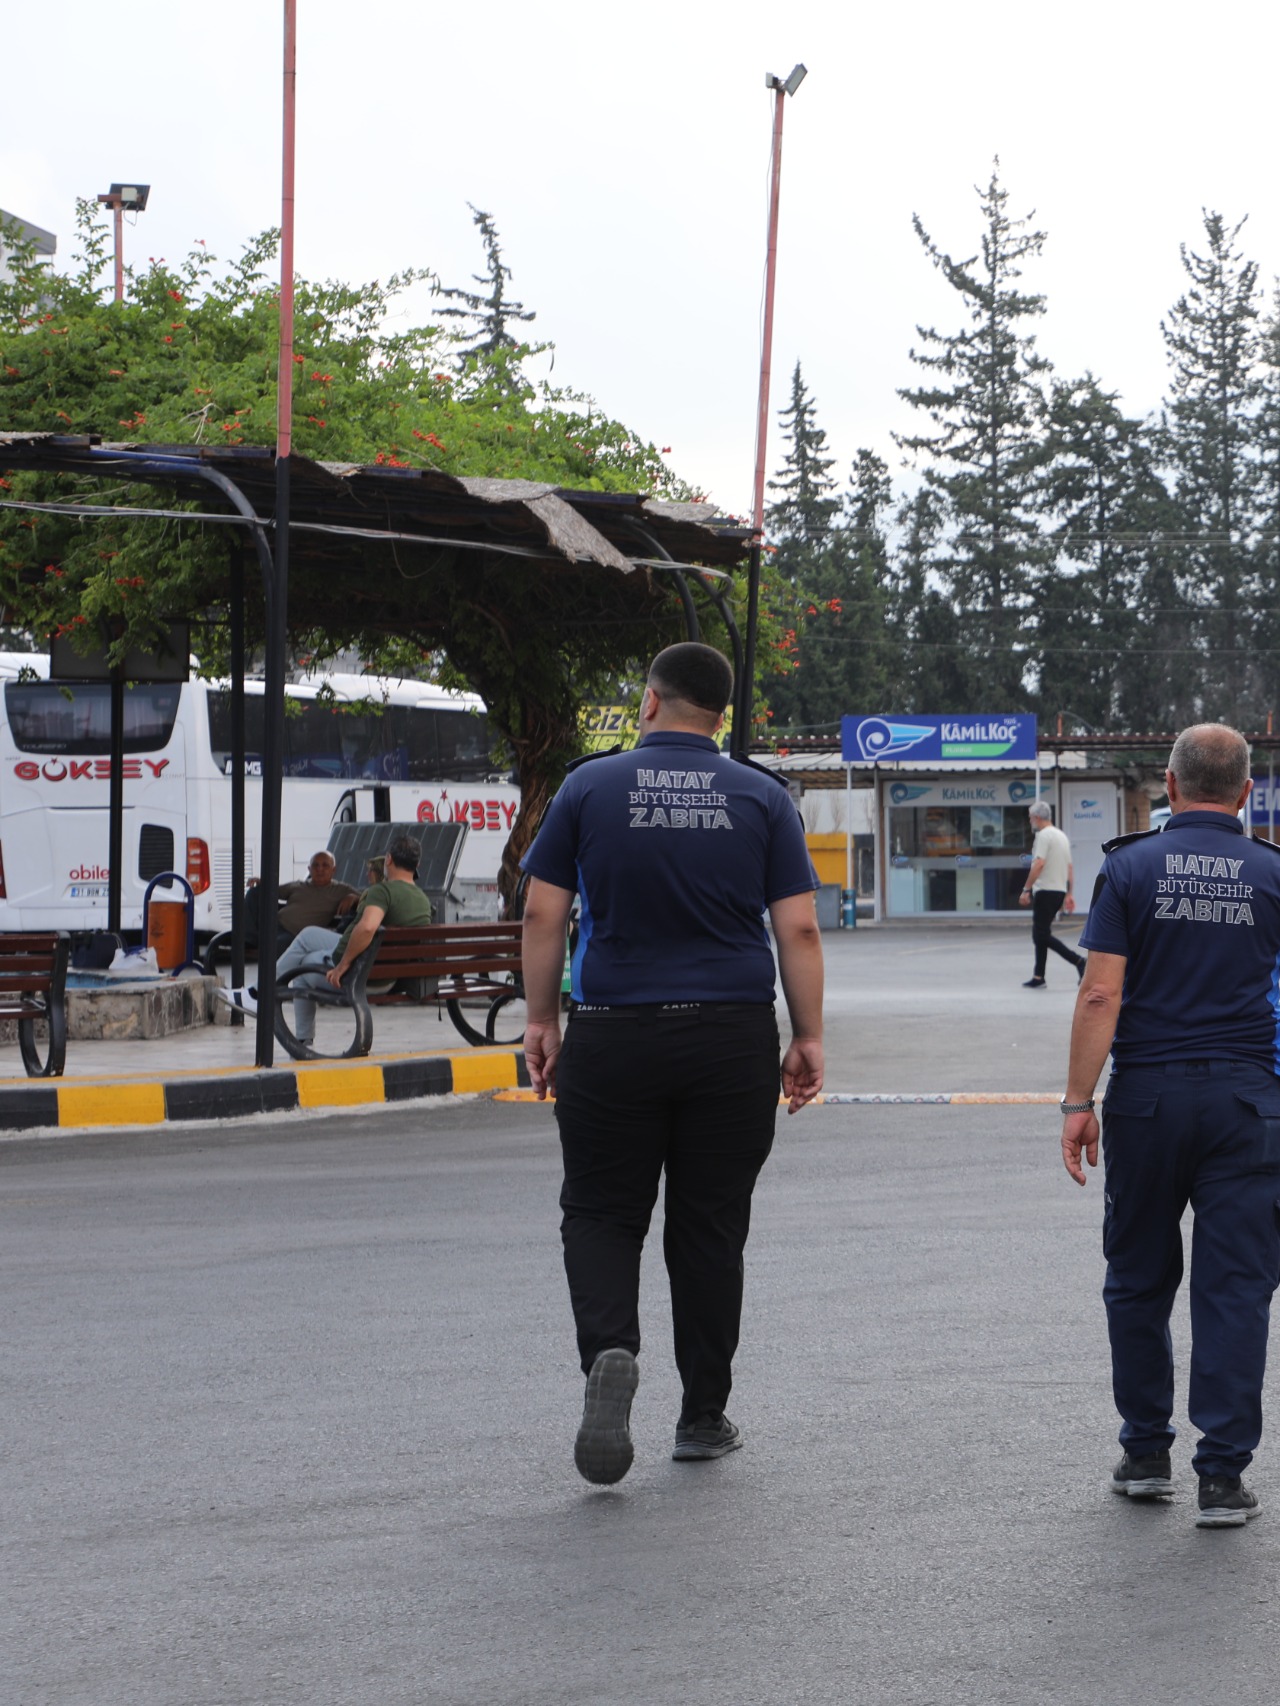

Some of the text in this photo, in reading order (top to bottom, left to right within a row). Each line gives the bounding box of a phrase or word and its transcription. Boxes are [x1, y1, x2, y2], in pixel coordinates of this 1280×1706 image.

[636, 769, 716, 789] HATAY
[628, 789, 728, 808] BÜYÜKŞEHİR
[629, 807, 733, 829] ZABITA
[69, 864, 110, 880] obile
[1166, 854, 1244, 879] HATAY
[1156, 876, 1253, 899] BÜYÜKŞEHİR
[1154, 897, 1254, 925] ZABITA
